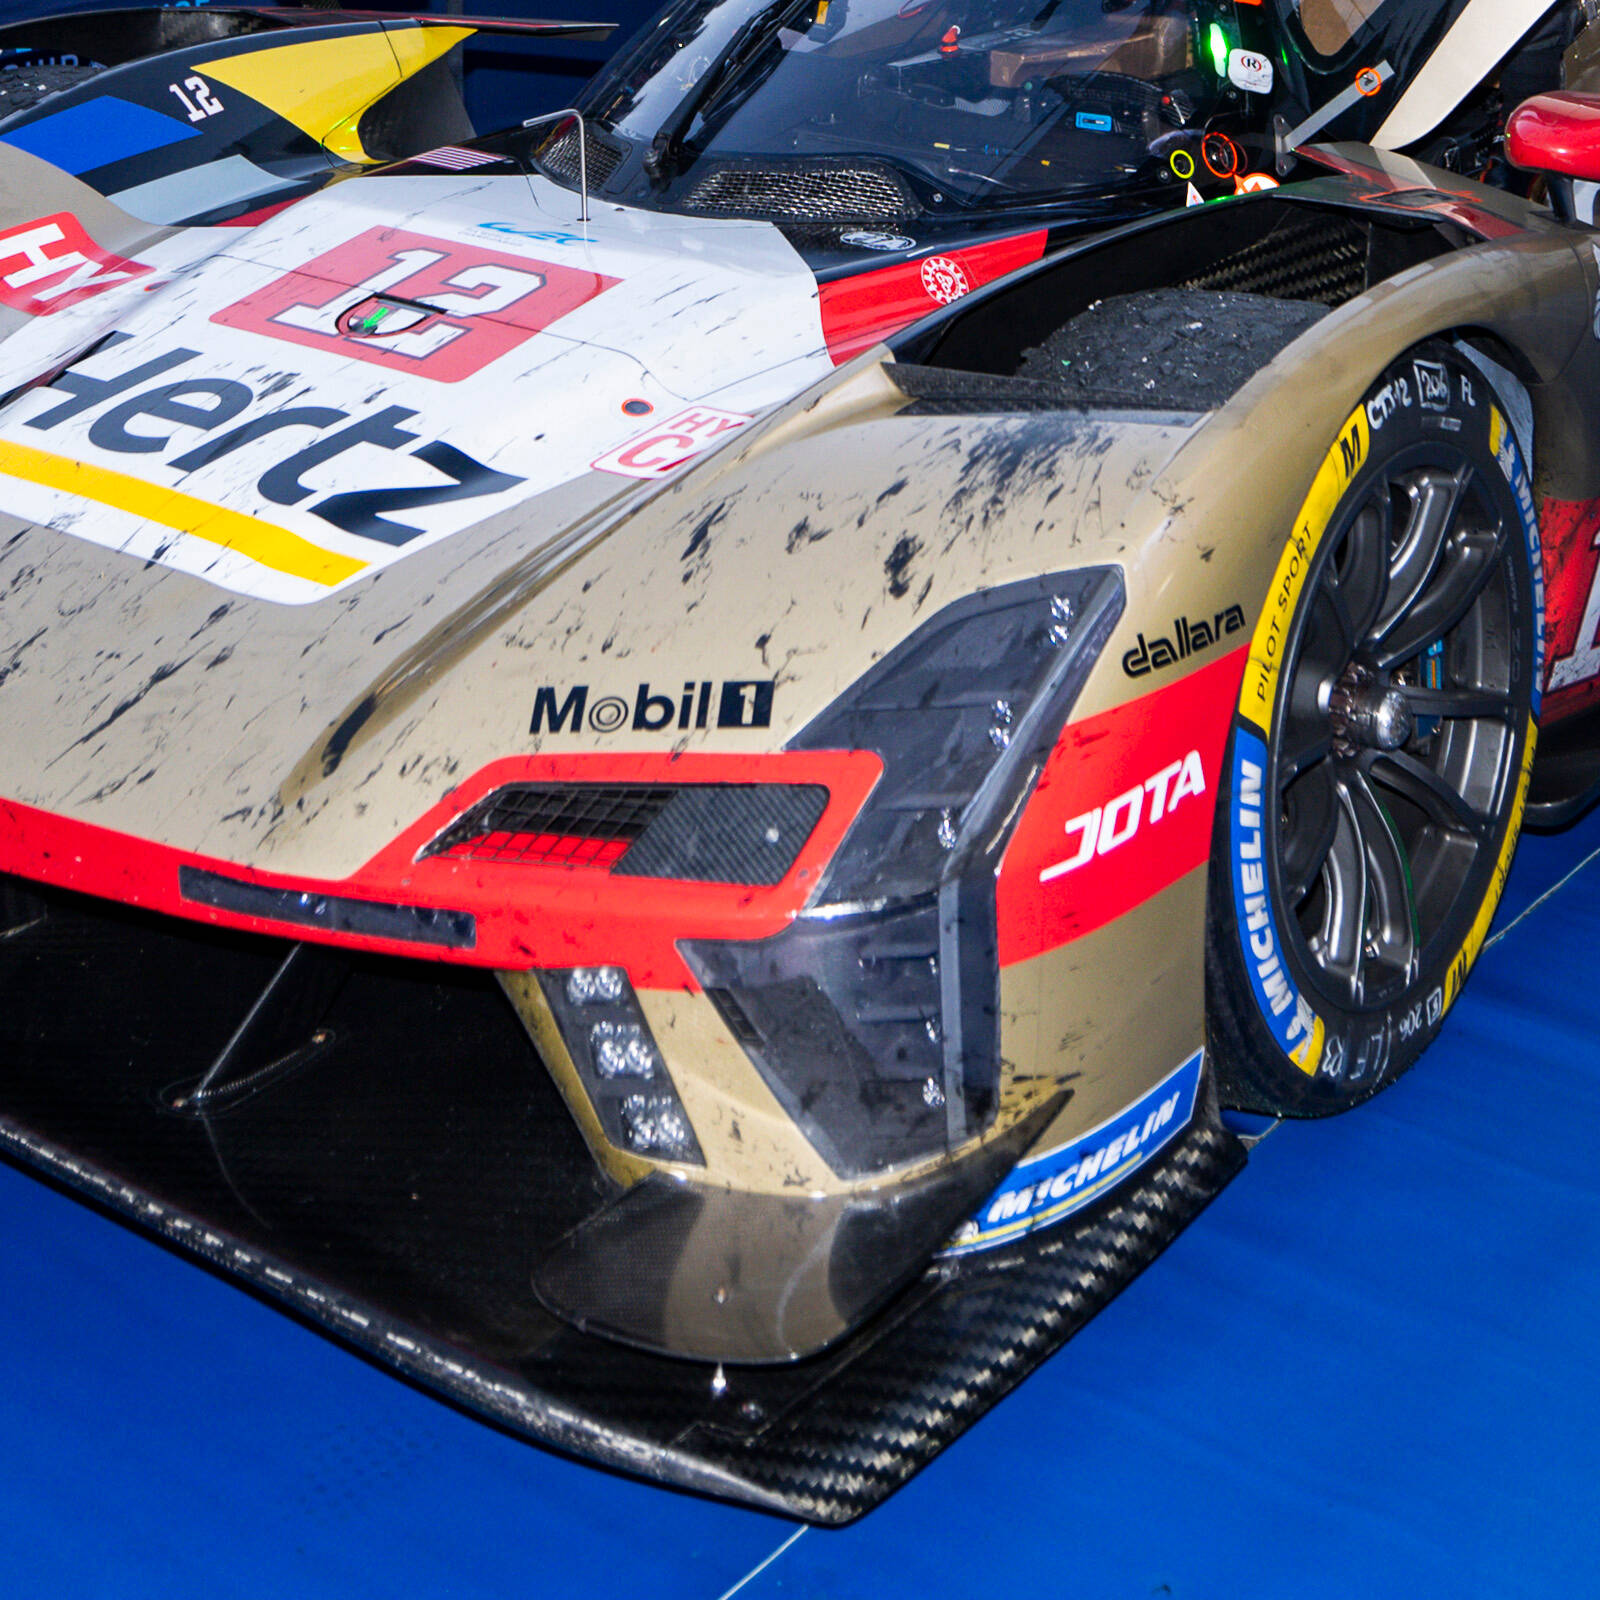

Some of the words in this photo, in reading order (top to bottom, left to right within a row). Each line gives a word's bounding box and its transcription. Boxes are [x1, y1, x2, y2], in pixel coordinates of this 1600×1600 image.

[169, 75, 225, 123] 12
[267, 247, 548, 361] 12
[1340, 423, 1362, 479] M
[1276, 520, 1313, 610] SPORT
[1514, 469, 1545, 694] MICHELIN
[1121, 603, 1248, 679] dallara
[1255, 615, 1282, 703] PILOT
[529, 681, 713, 735] Mobil
[1039, 750, 1206, 883] JOTA
[1238, 759, 1293, 1017] MICHELIN
[986, 1091, 1181, 1223] MICHELIN
